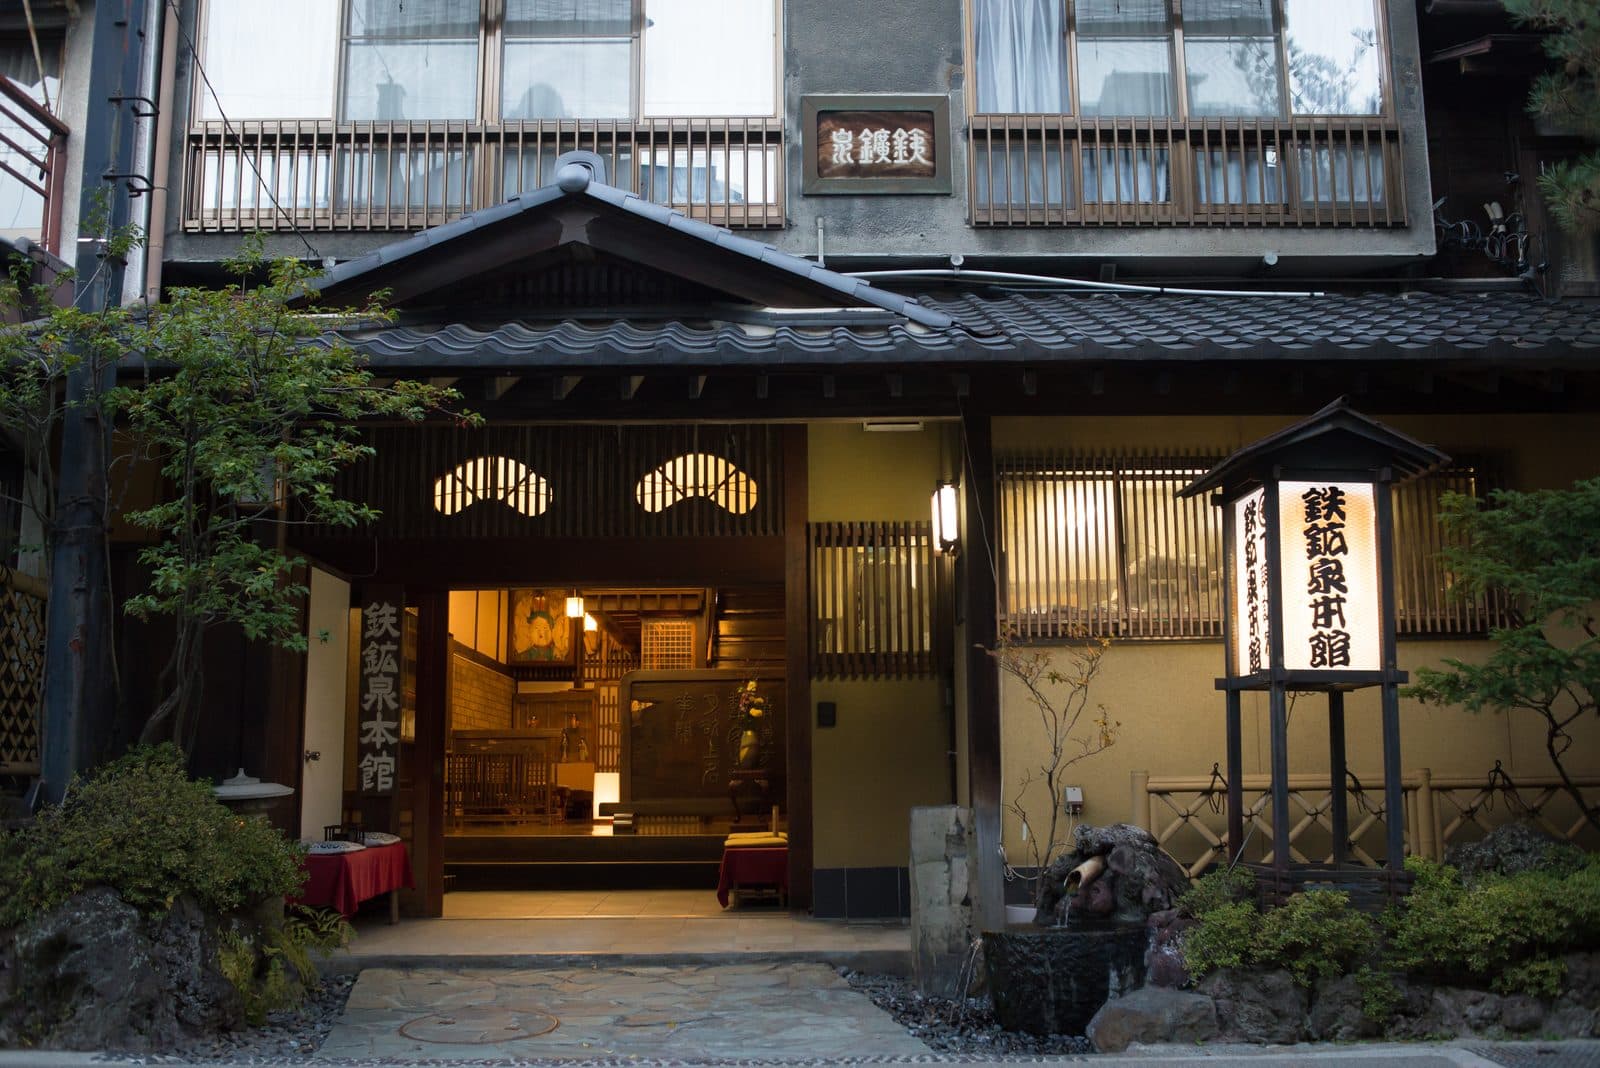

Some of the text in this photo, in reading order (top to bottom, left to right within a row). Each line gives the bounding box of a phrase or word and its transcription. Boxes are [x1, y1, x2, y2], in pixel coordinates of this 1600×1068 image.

[1302, 486, 1351, 668] 鉄鉱泉本館
[359, 601, 401, 793] 鉄鉱泉本館
